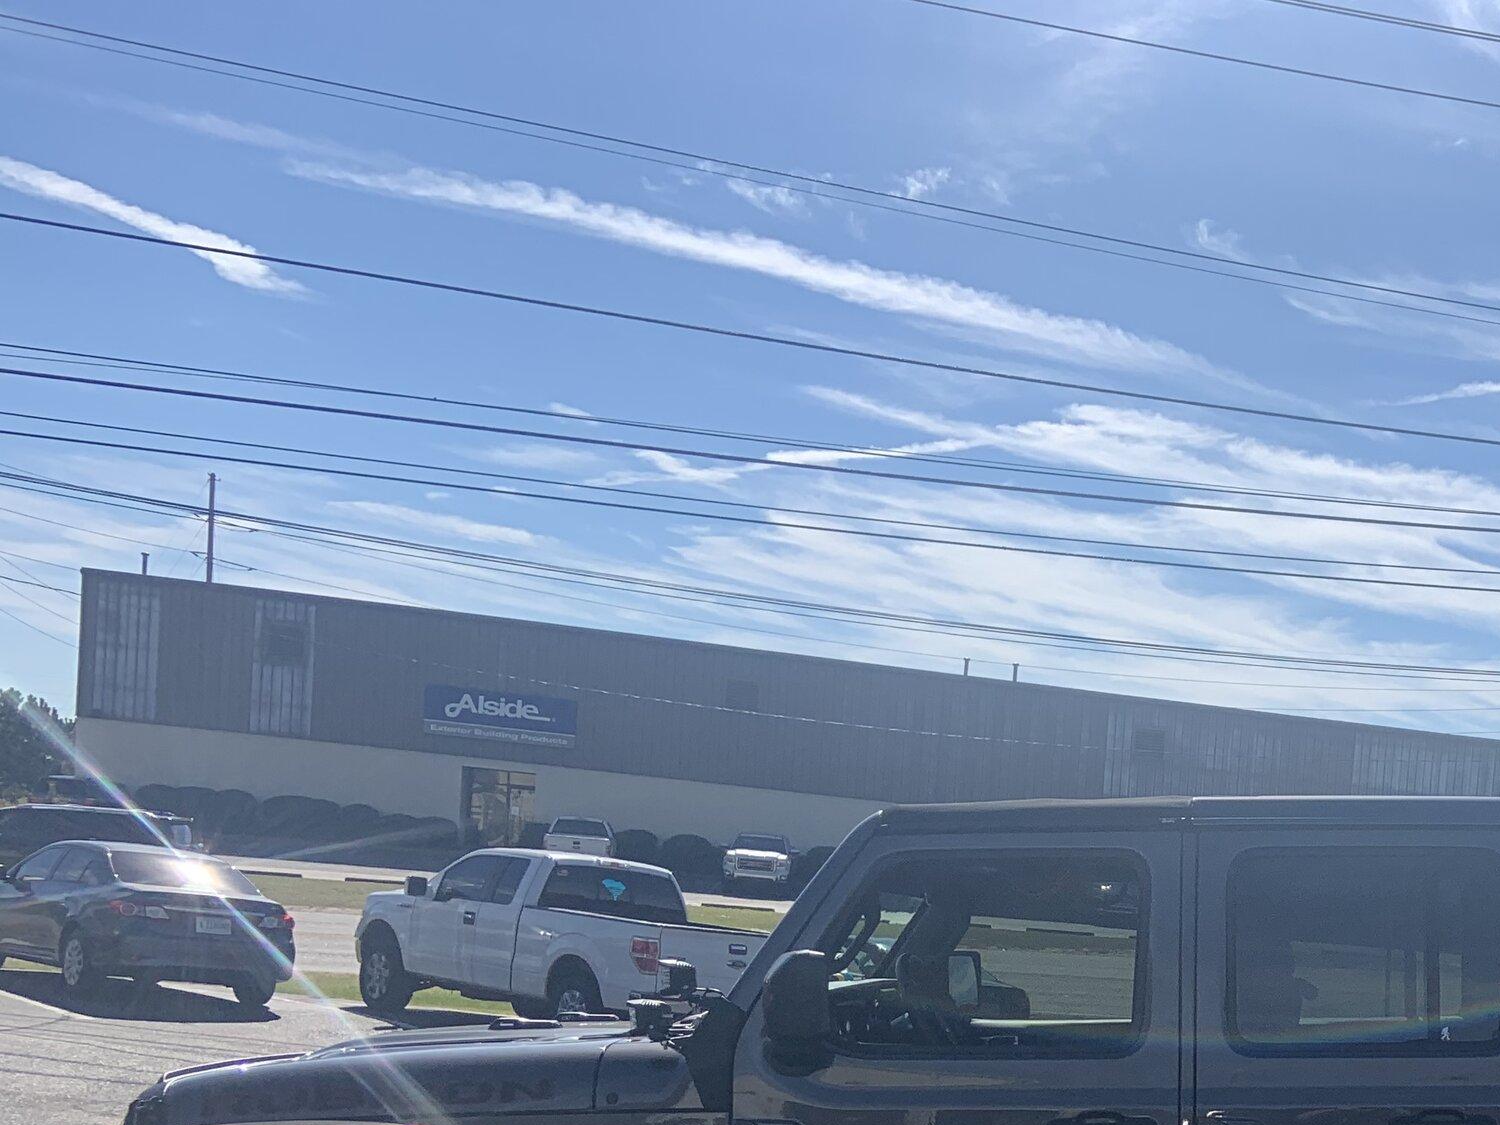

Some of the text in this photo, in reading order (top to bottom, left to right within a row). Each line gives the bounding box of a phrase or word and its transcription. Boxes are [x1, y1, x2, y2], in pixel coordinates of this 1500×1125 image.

[444, 693, 551, 722] Alside
[430, 723, 568, 745] Exterior Building Products
